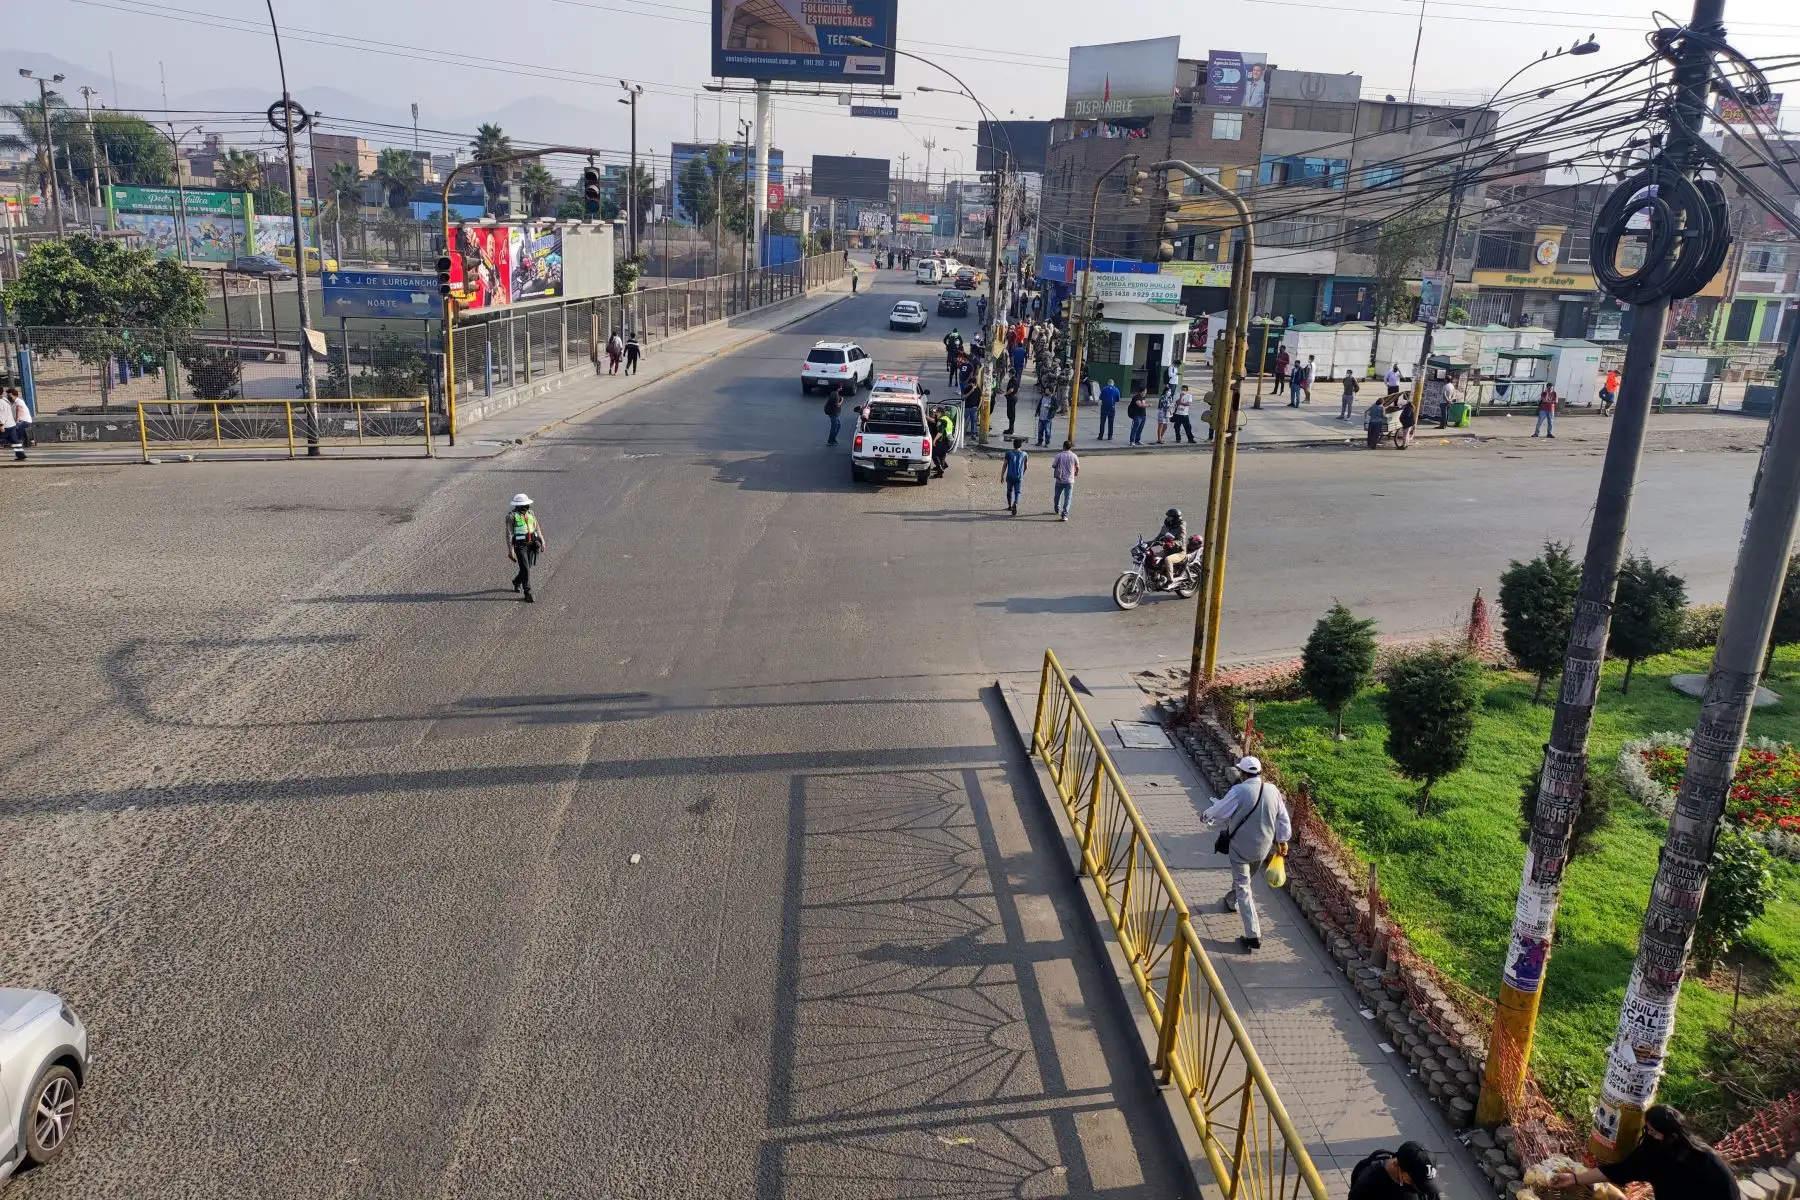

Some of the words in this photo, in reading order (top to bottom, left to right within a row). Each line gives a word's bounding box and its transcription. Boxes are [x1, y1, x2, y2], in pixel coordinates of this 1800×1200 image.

[802, 4, 853, 14] SOLUCIONES
[807, 15, 873, 27] ESTRUCTURALES
[1075, 99, 1133, 116] DISPONIBLE
[366, 277, 378, 285] DE
[383, 278, 438, 287] LURIGANCHO
[367, 299, 397, 308] NORTE
[872, 445, 912, 454] POLICIA
[1425, 1164, 1437, 1179] LA
